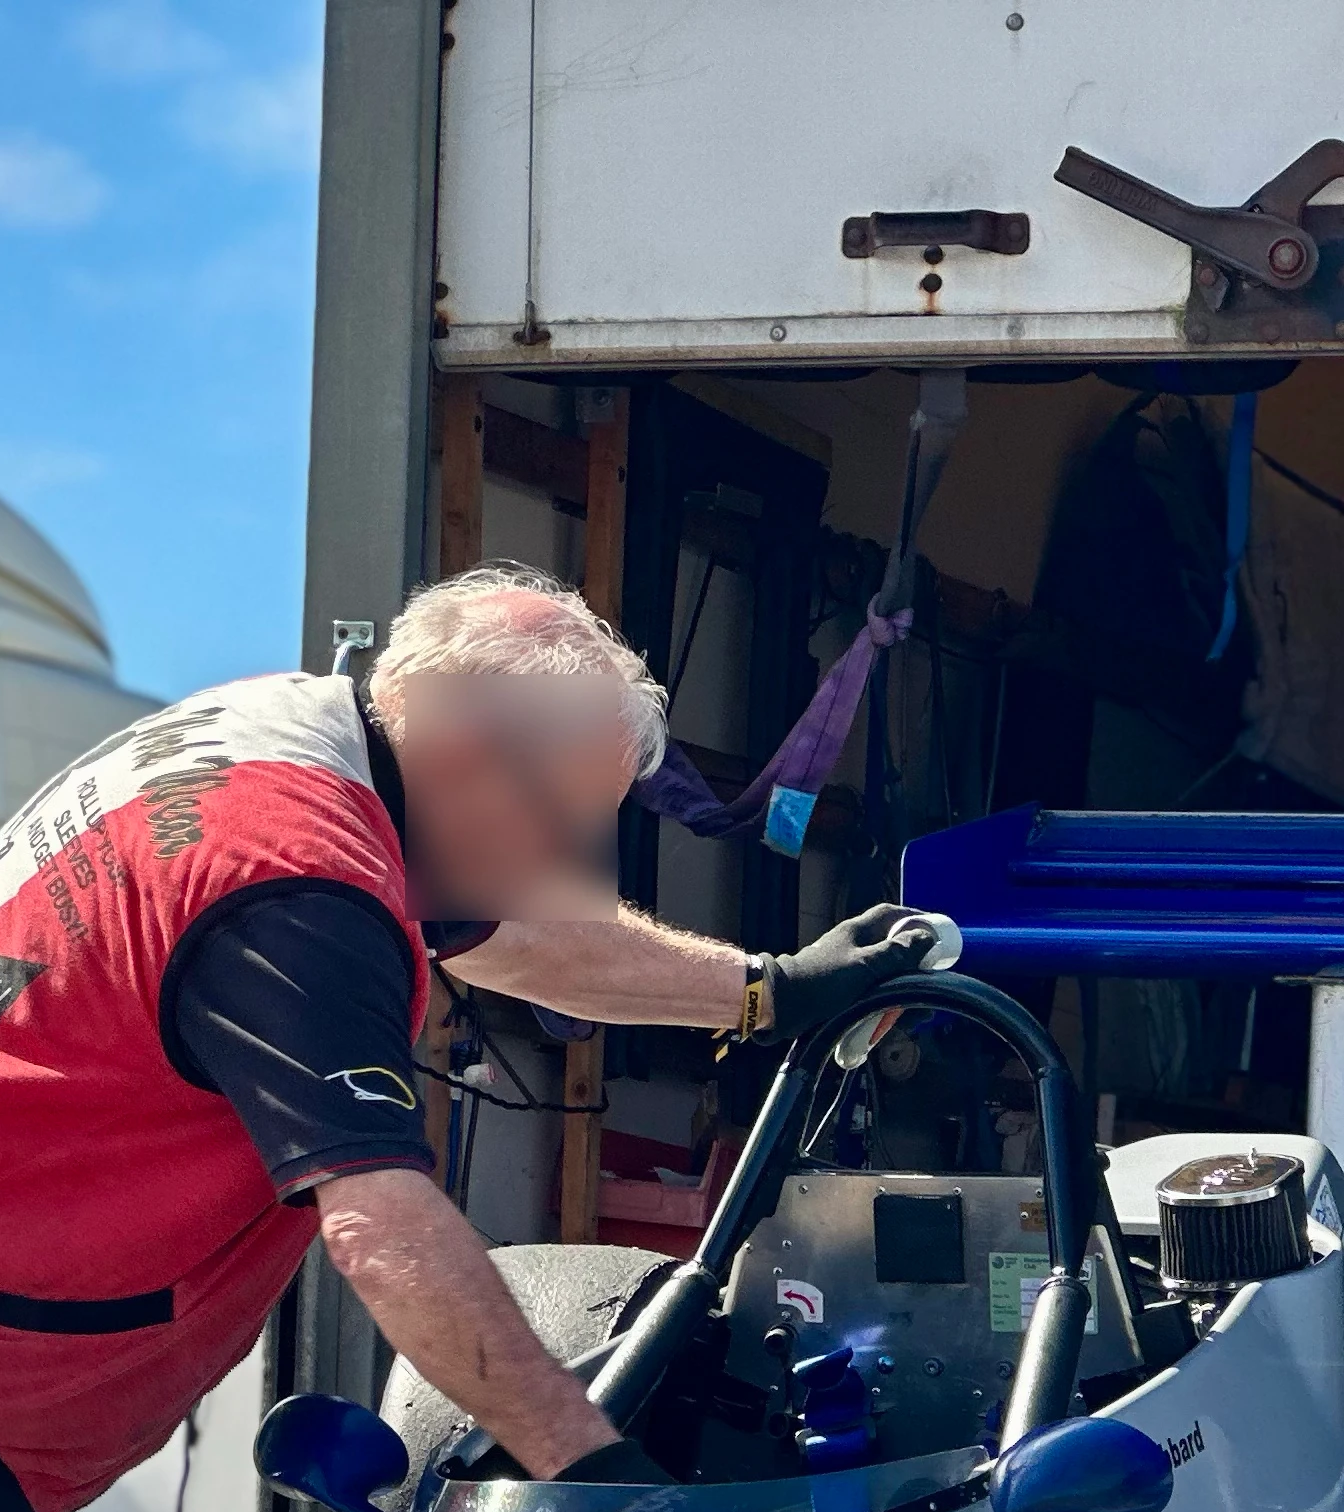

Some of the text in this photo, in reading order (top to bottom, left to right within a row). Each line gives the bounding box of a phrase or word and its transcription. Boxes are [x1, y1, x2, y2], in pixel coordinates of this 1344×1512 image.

[76, 775, 100, 817] ROLL
[27, 815, 46, 848] AND
[86, 807, 106, 835] UP
[34, 842, 59, 880] GET
[53, 809, 97, 889] SLEEVES
